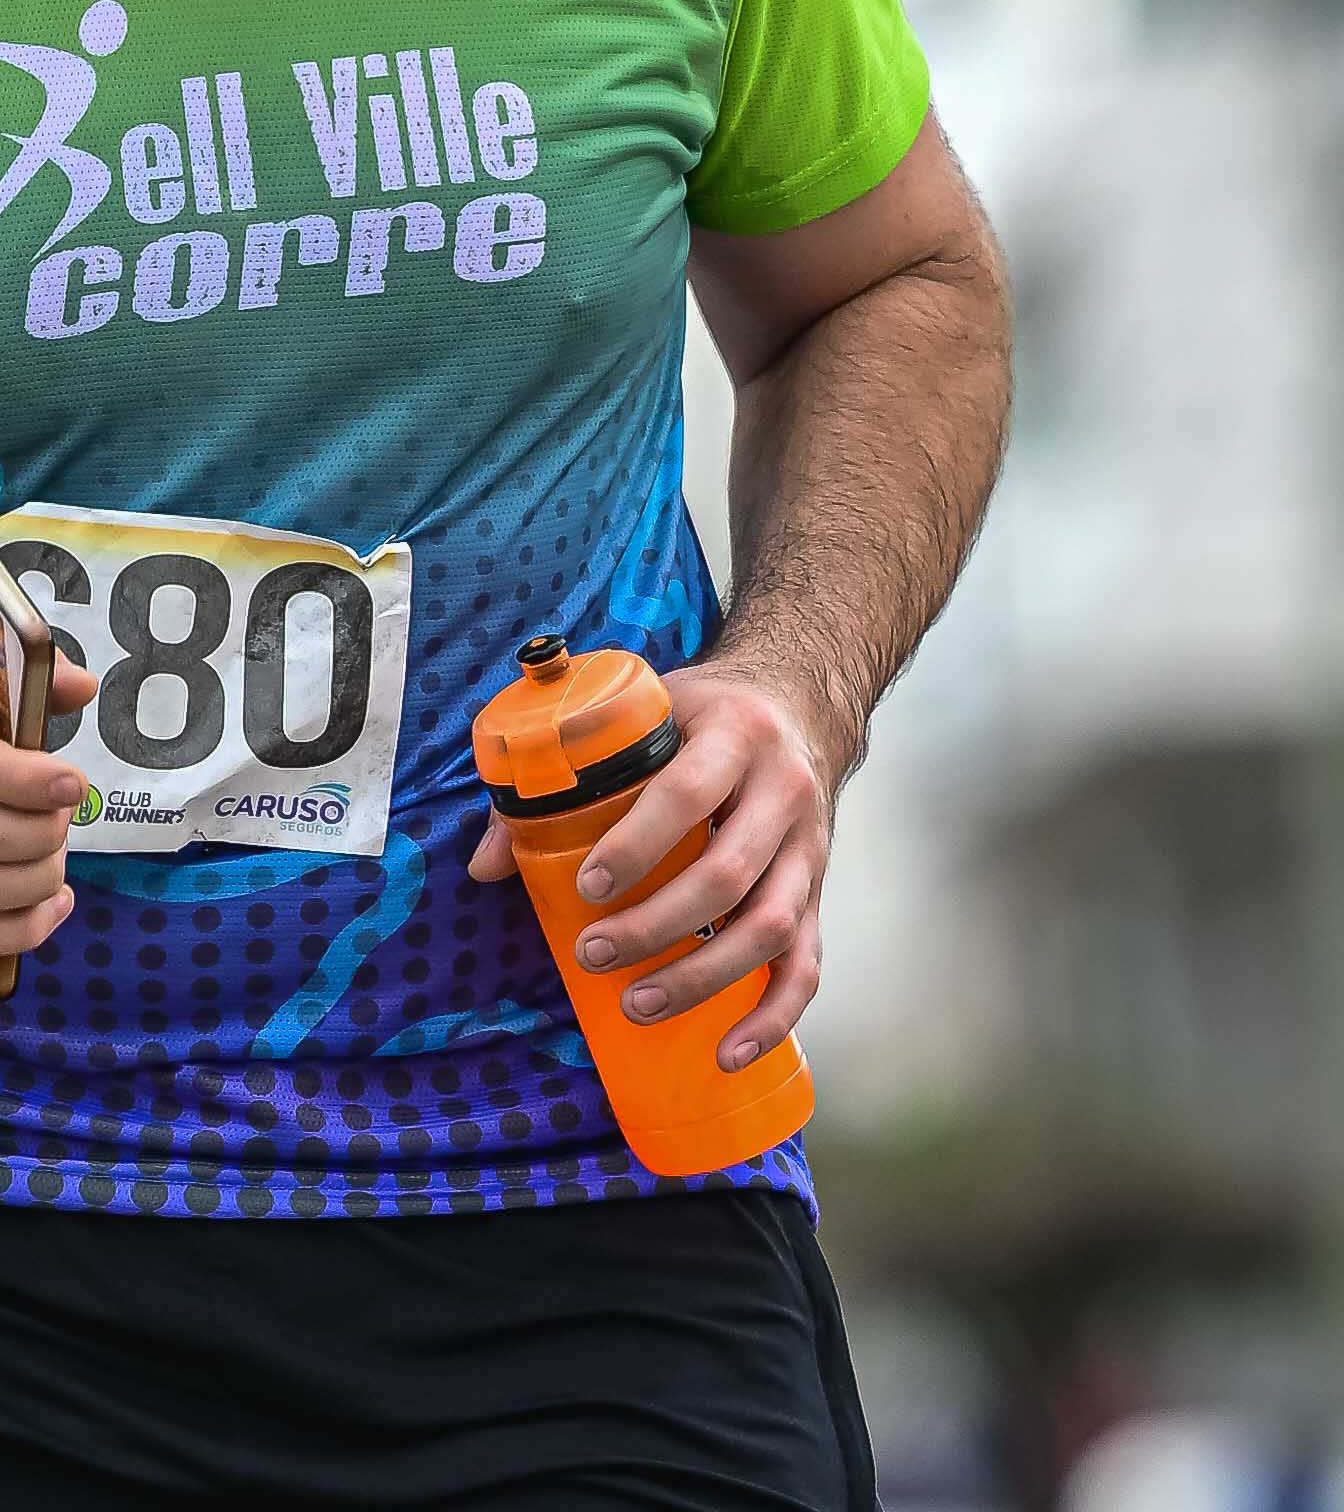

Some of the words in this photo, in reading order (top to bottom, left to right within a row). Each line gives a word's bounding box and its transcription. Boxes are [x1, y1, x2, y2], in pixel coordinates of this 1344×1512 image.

[291, 46, 538, 199] Ville
[23, 191, 547, 340] corre
[107, 789, 152, 808] CLUB
[214, 794, 345, 825] CARUSO
[279, 821, 343, 836] SEGUROS
